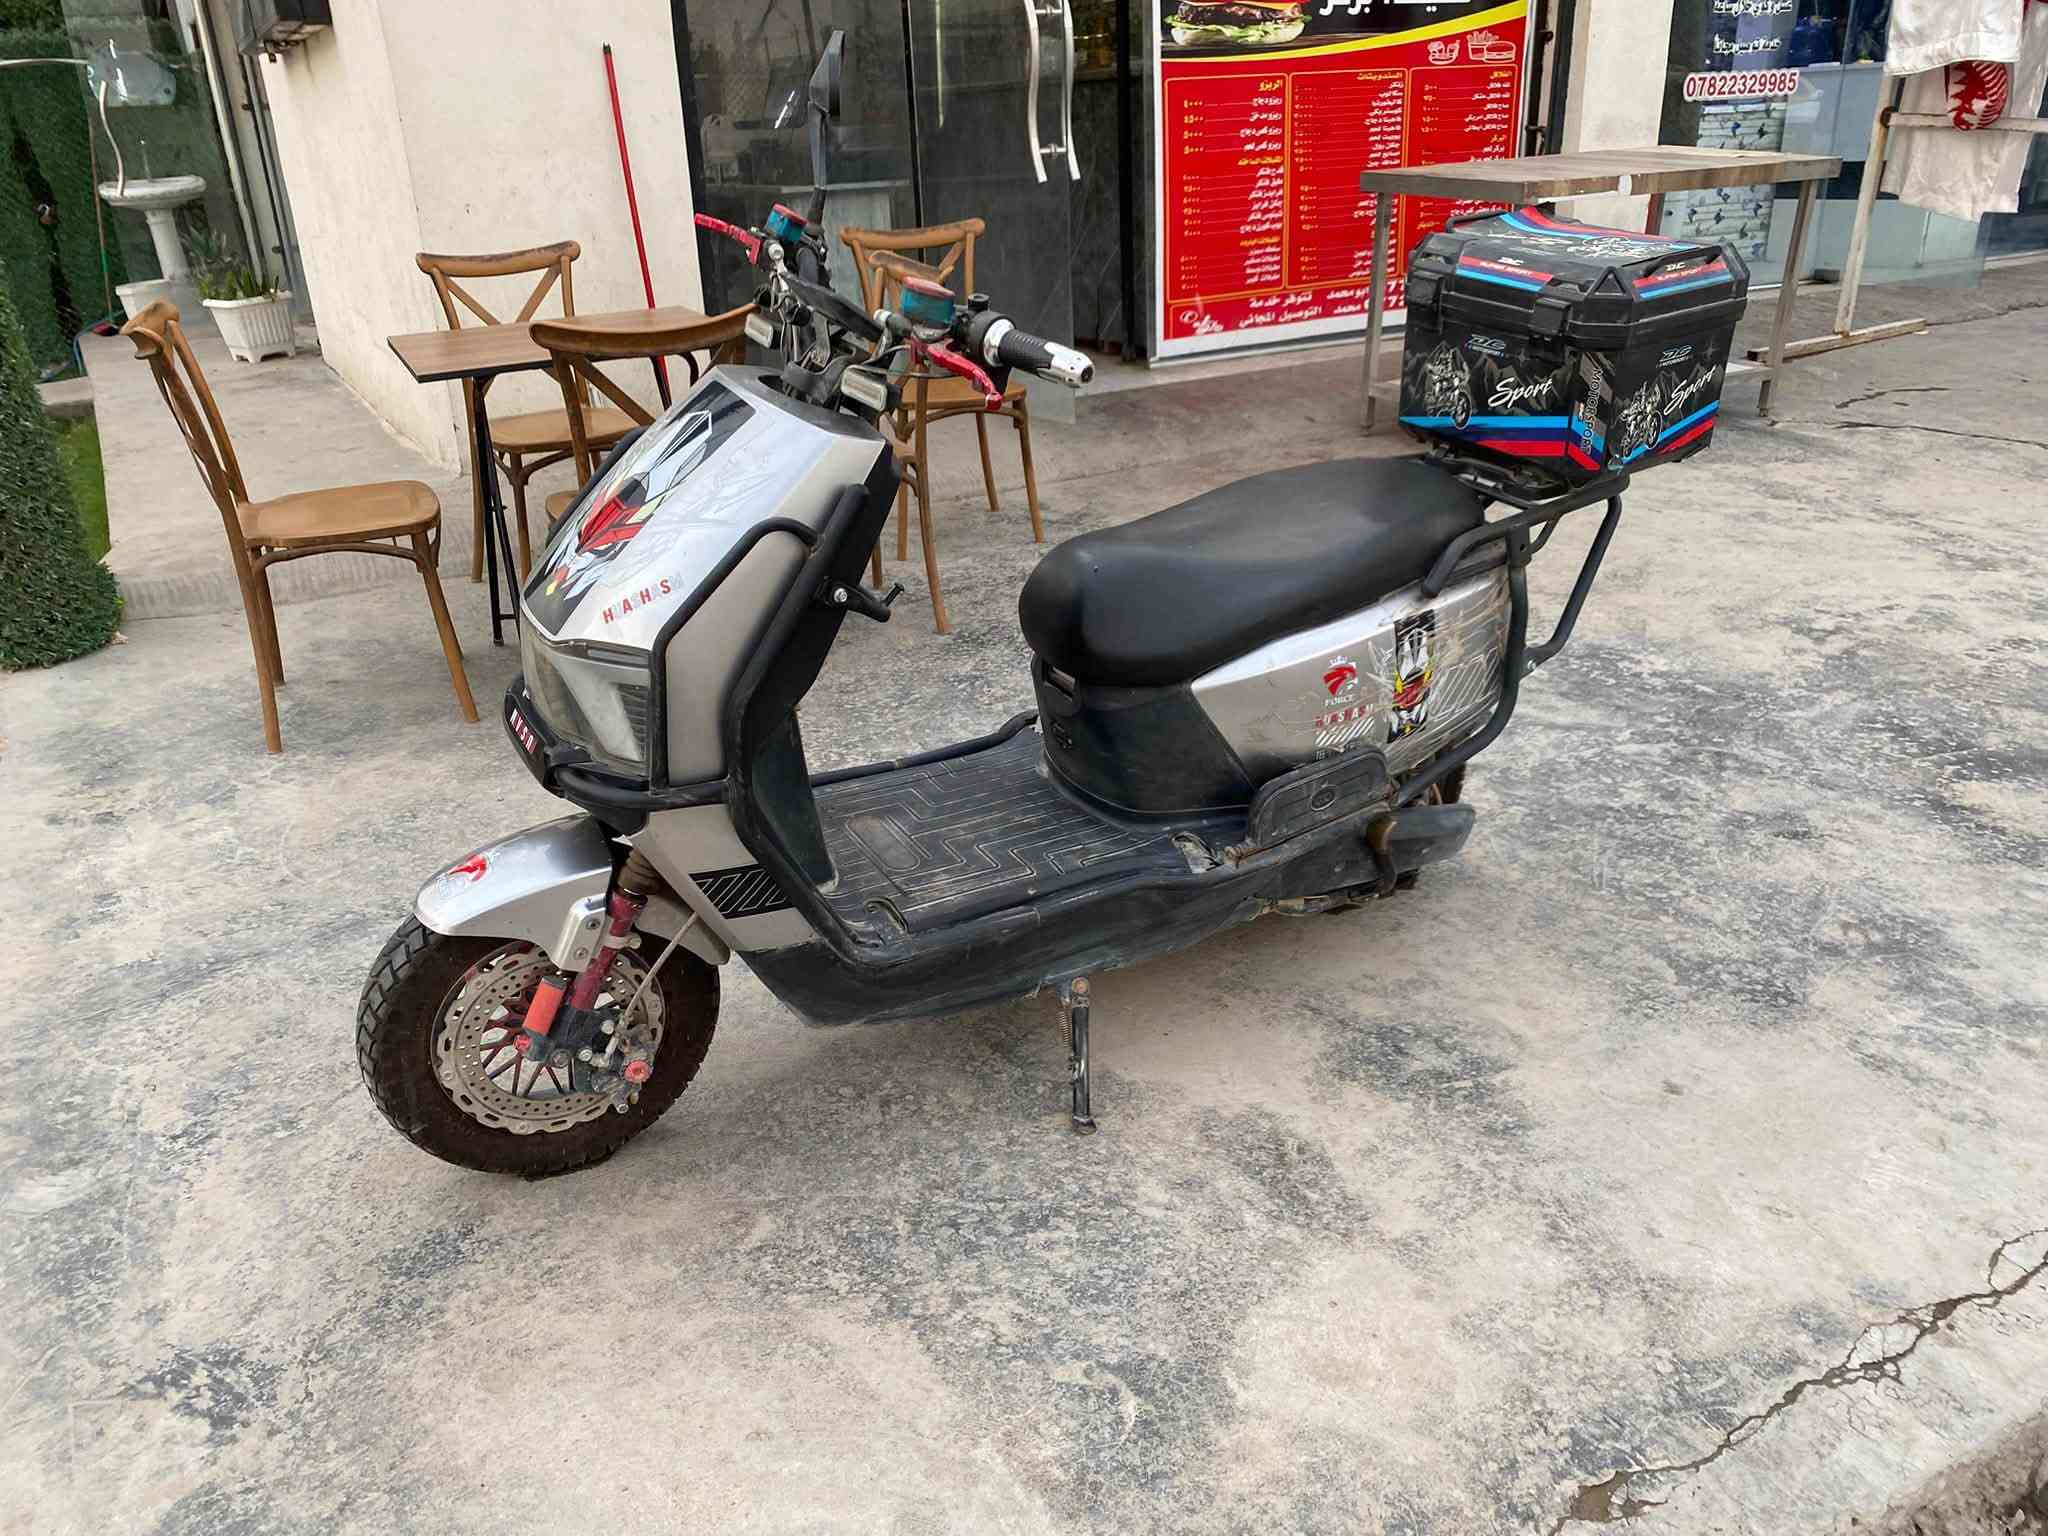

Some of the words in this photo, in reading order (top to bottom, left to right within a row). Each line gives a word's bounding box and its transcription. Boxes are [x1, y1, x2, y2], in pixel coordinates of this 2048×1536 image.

[1686, 72, 1797, 97] 07822329985
[1249, 296, 1281, 309] خدمة
[1283, 291, 1313, 306] تتوفر
[1326, 288, 1354, 300] محمد
[1238, 312, 1276, 329] المجاني
[1278, 305, 1323, 322] التوصيل
[1487, 377, 1553, 409] Sport
[1663, 364, 1717, 416] Sport
[1579, 367, 1603, 456] MOTORSPORT
